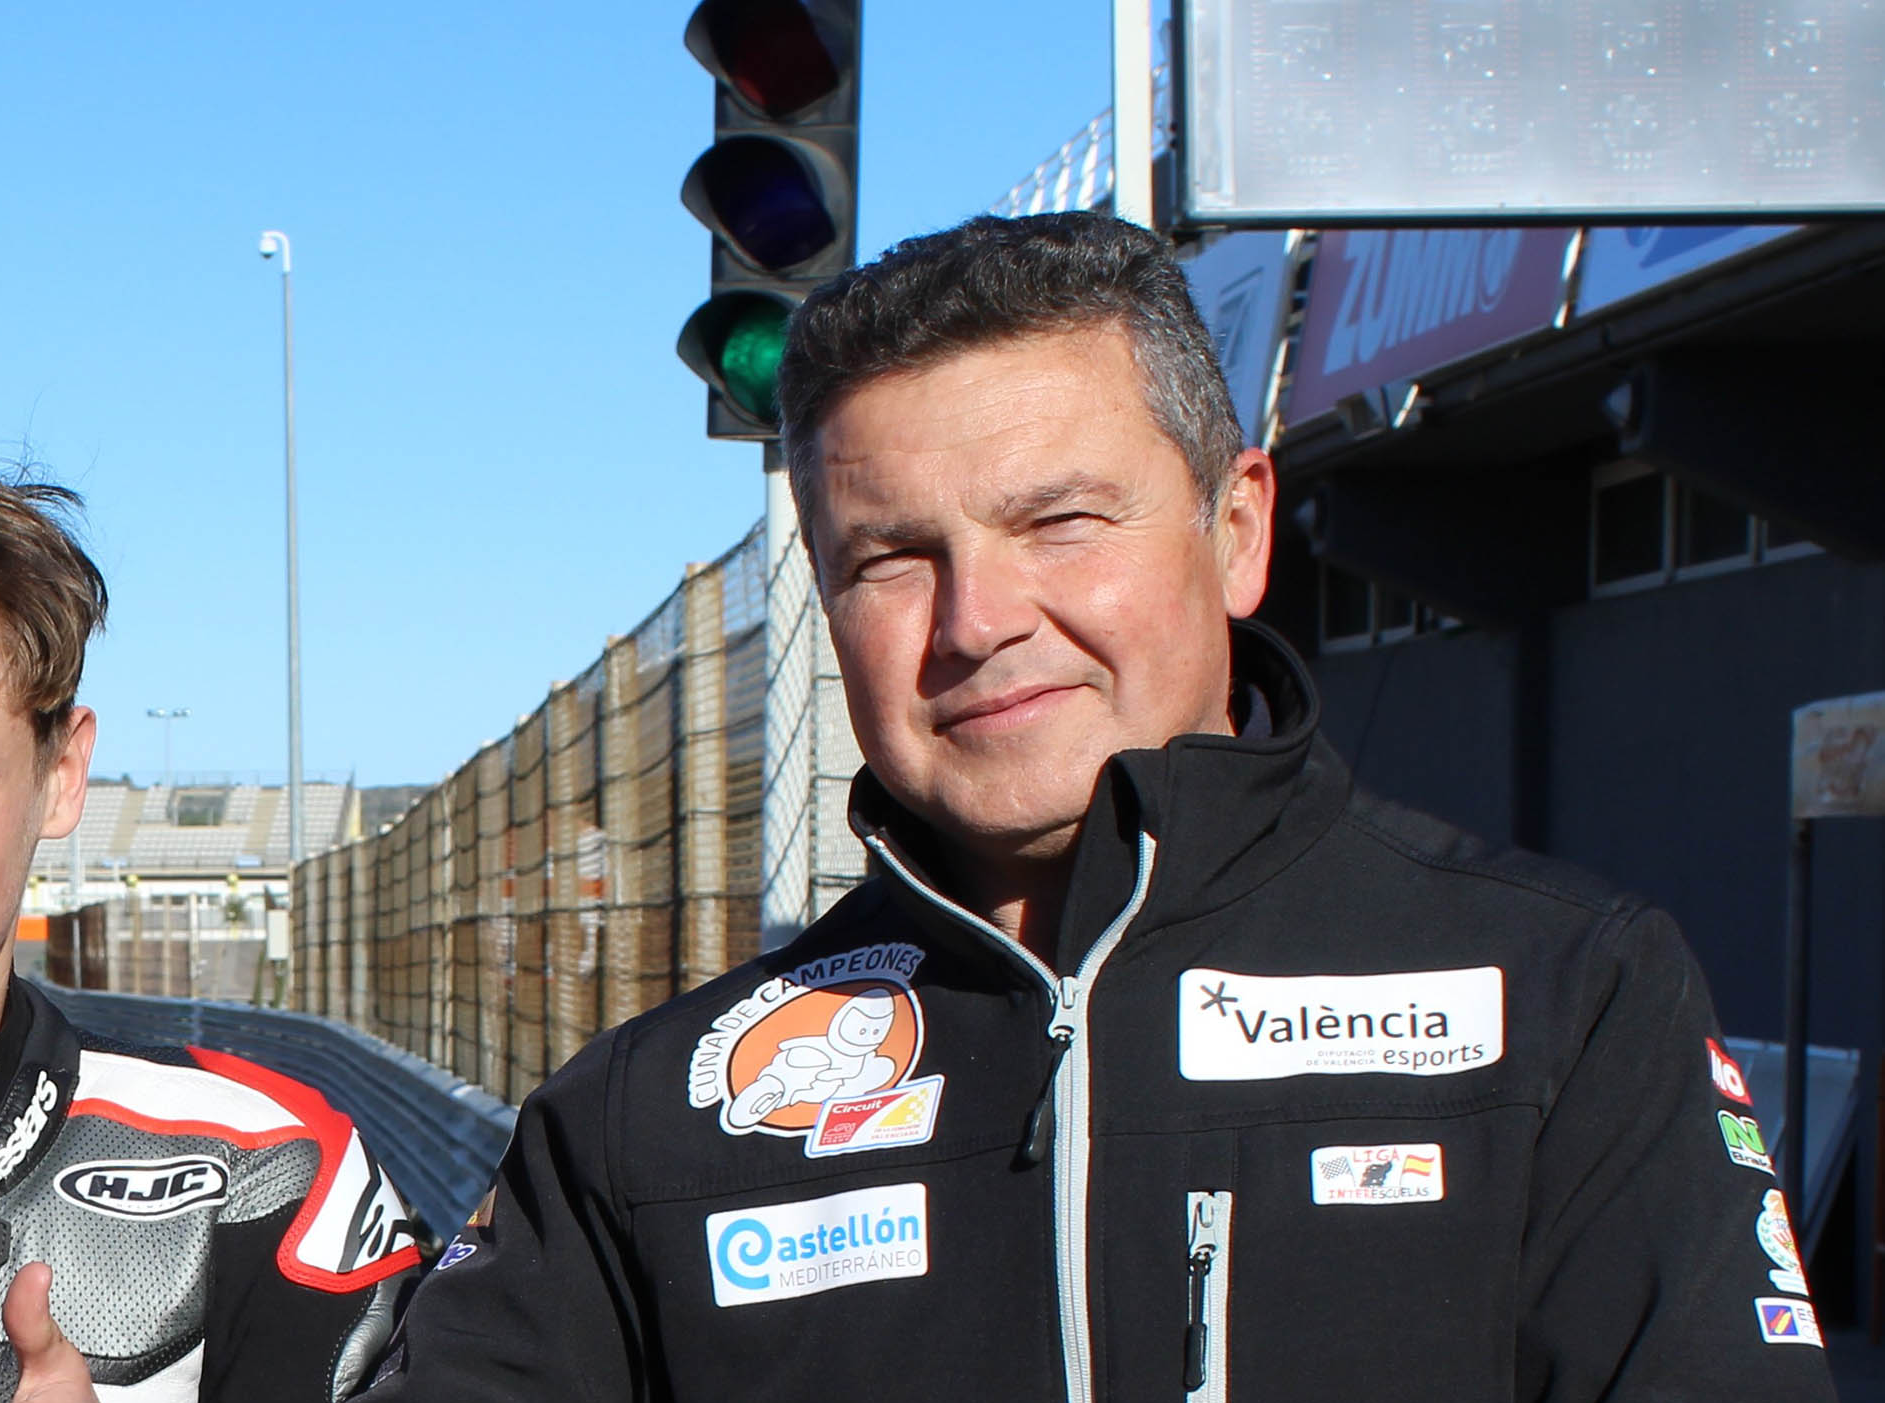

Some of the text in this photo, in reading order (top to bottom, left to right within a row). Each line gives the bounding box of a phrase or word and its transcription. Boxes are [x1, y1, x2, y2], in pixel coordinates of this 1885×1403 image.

[696, 947, 921, 1103] CUNA DE CAMPEONES
[1235, 1003, 1449, 1043] València
[1383, 1043, 1484, 1070] esports
[832, 1099, 883, 1114] Circuit
[1353, 1147, 1400, 1162] LIGA
[88, 1167, 209, 1200] HJC
[1328, 1187, 1430, 1199] INTERESCUELAS
[716, 1206, 919, 1290] Castellón
[779, 1249, 922, 1289] MEDITERRÁNEO
